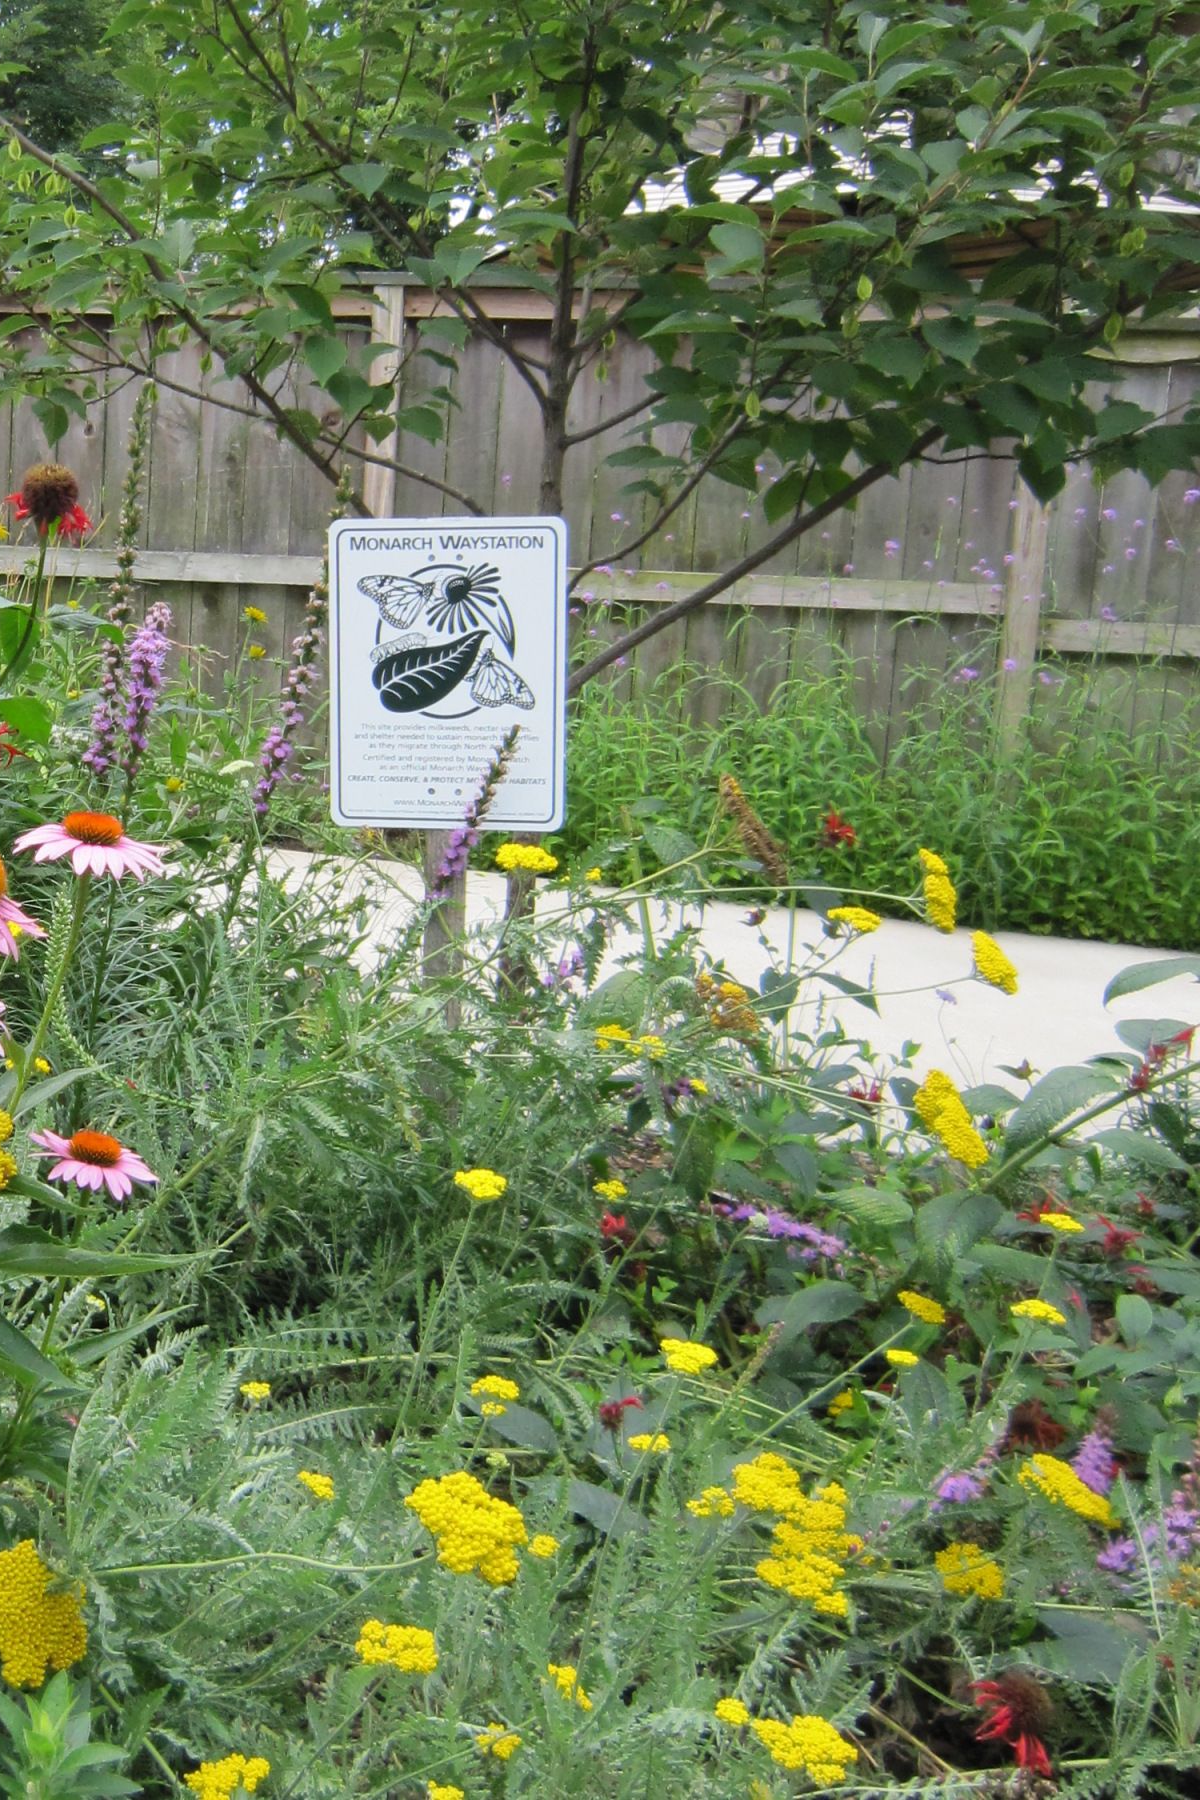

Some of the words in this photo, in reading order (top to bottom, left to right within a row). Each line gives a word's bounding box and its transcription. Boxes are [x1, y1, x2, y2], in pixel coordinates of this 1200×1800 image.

[349, 536, 433, 551] MONARCH
[439, 534, 544, 550] WAYSTATION
[393, 723, 426, 732] provides
[378, 742, 395, 750] they
[398, 743, 428, 751] migrate
[430, 743, 462, 751] through
[362, 753, 396, 761] Certified
[415, 754, 454, 763] registered
[456, 755, 465, 763] by
[430, 764, 464, 772] Monarch
[431, 776, 464, 784] PROTECT
[509, 777, 546, 785] HABITATS
